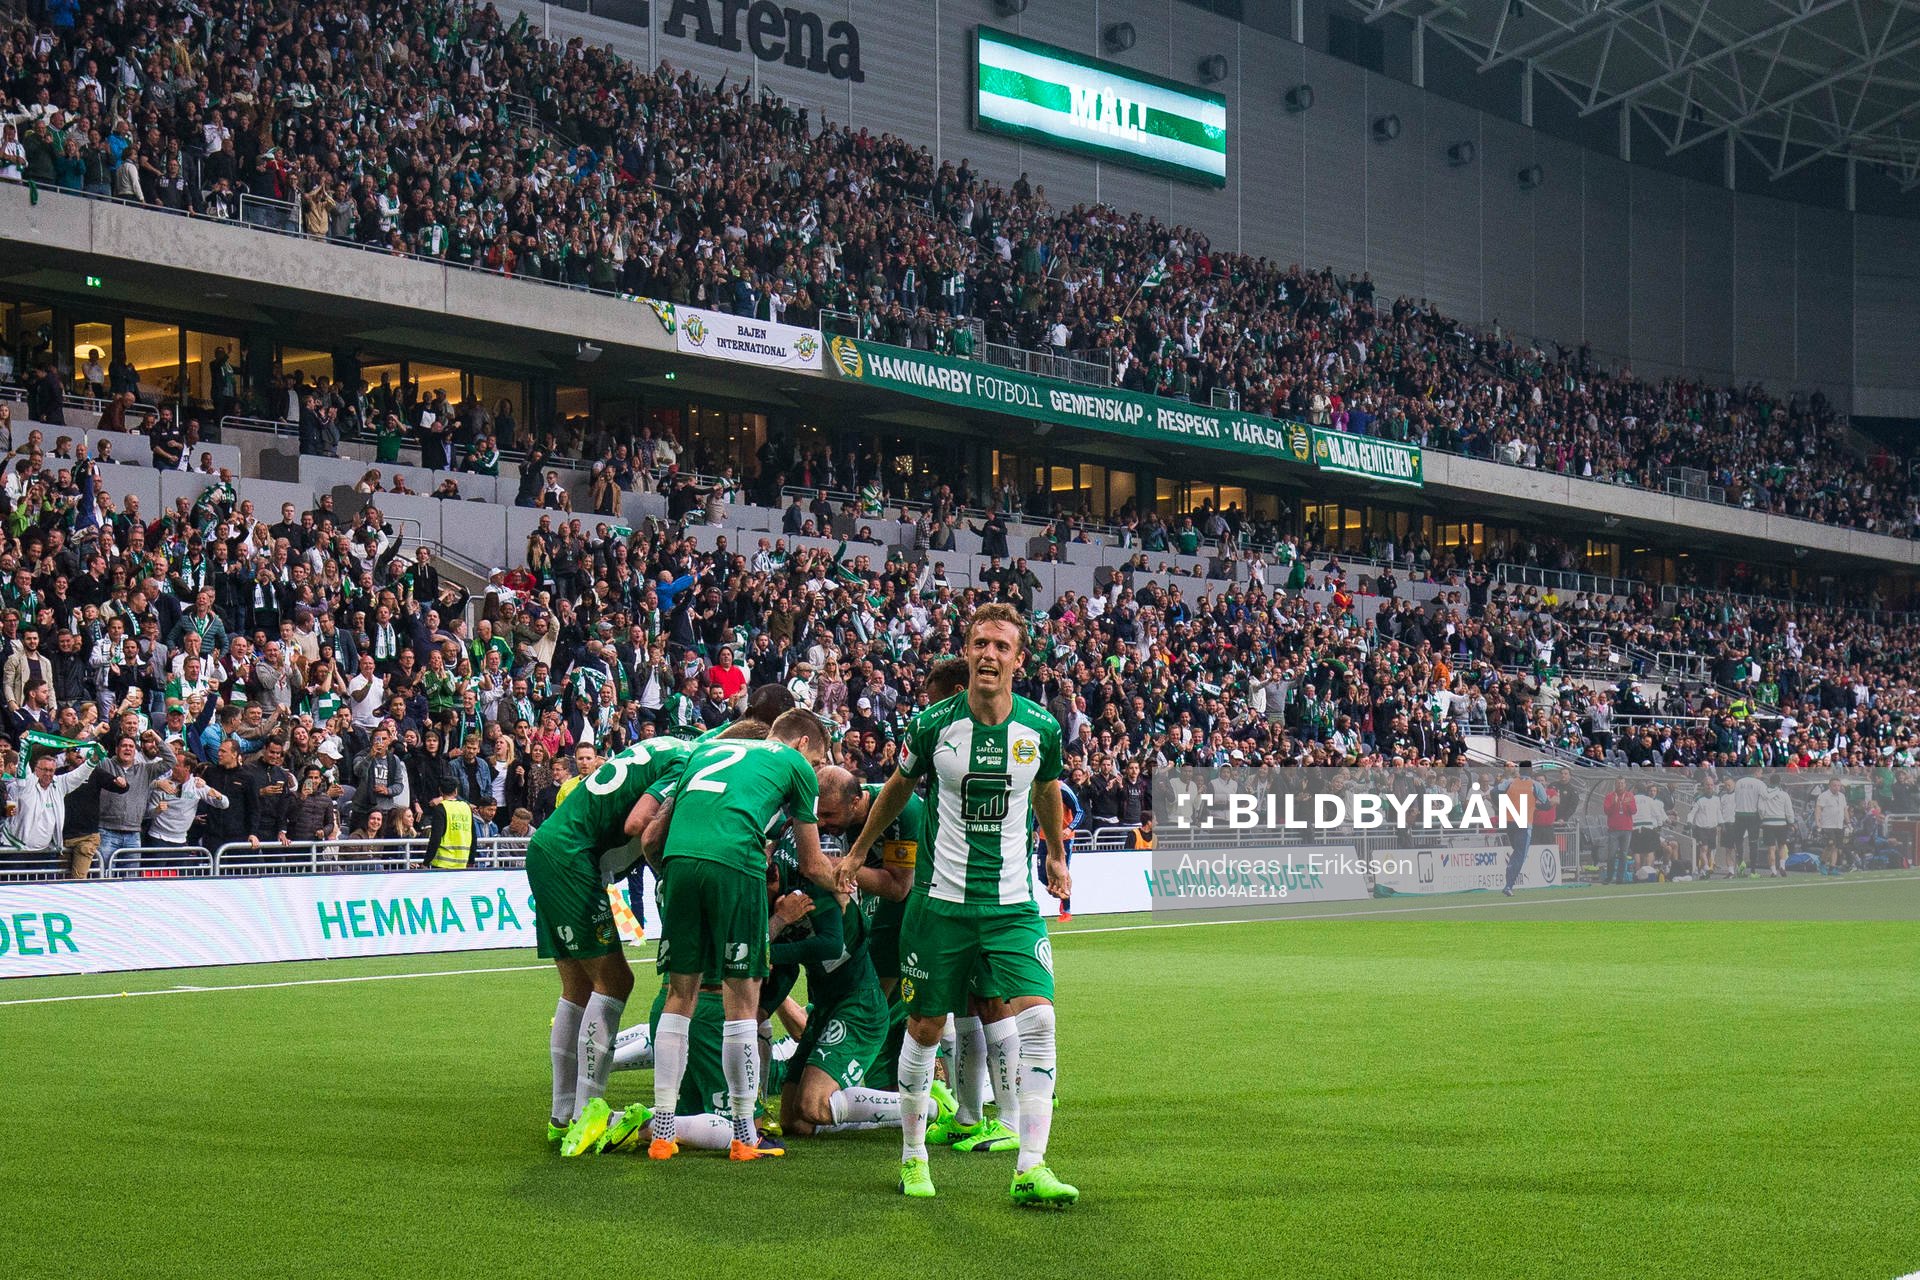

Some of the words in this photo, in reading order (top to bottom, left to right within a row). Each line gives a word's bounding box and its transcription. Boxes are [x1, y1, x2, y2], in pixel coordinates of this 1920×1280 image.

[663, 0, 865, 83] Arena
[1069, 85, 1147, 143] MÅL!
[716, 337, 787, 358] INTERNATIONAL
[737, 325, 767, 340] BAJEN
[867, 353, 972, 395] HAMMARBY
[975, 375, 1043, 409] FOTBOLL
[1049, 389, 1144, 426] GEMENSKAP
[1156, 407, 1220, 439] RESPEKT
[1326, 435, 1360, 469] BAJEN
[1358, 442, 1413, 478] GENTLEMEN
[1027, 708, 1053, 724] MEGA
[686, 744, 748, 793] 2
[1144, 866, 1221, 897] HEMMA
[1451, 852, 1498, 867] INTERSPORT
[317, 896, 466, 939] HEMMA
[470, 887, 522, 932] PÅ
[585, 1021, 597, 1080] KVARNEN
[743, 1043, 755, 1091] KVARNEN
[995, 1042, 1010, 1091] VARNEN
